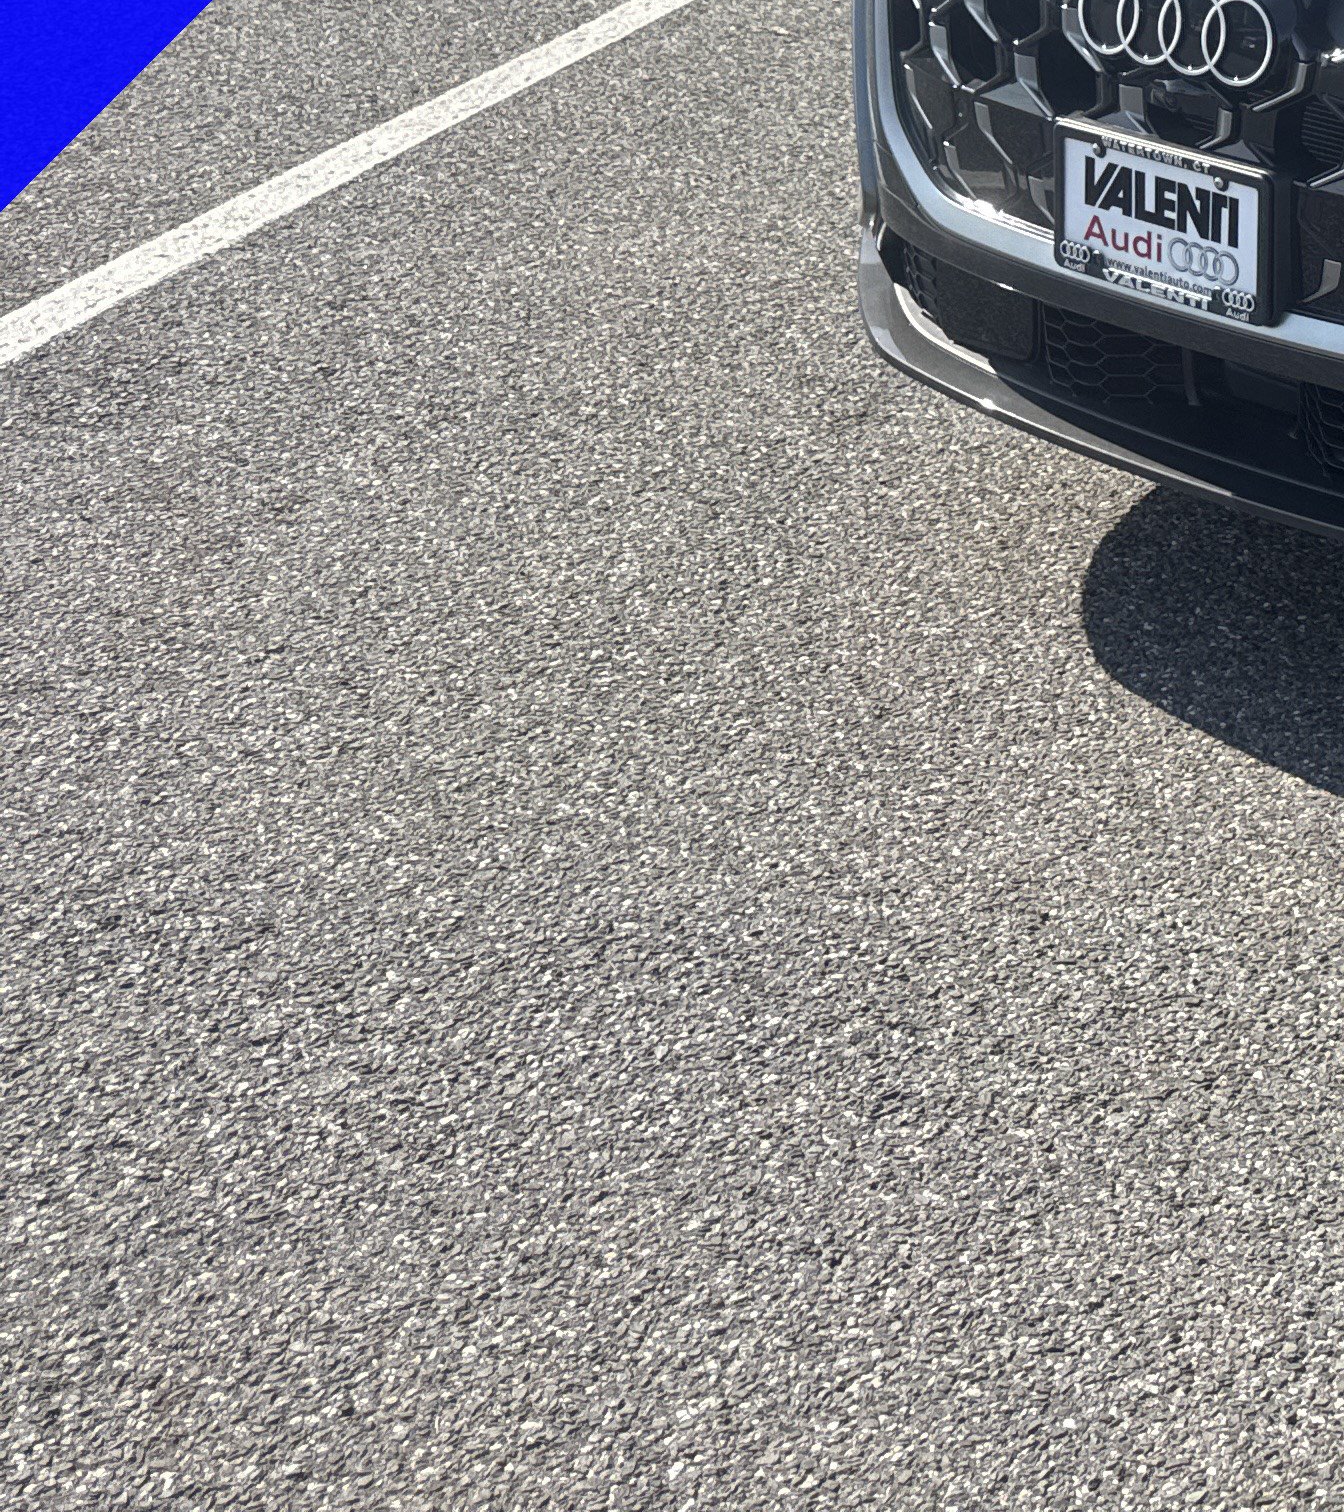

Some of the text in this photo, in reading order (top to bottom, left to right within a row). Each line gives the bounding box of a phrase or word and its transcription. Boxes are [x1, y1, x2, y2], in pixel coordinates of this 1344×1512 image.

[1192, 160, 1211, 174] CT
[1084, 155, 1239, 249] VALENTI
[1083, 215, 1162, 263] Audi
[1063, 258, 1086, 273] Audi
[1102, 267, 1213, 311] VALENTI
[1225, 307, 1250, 323] Audi
